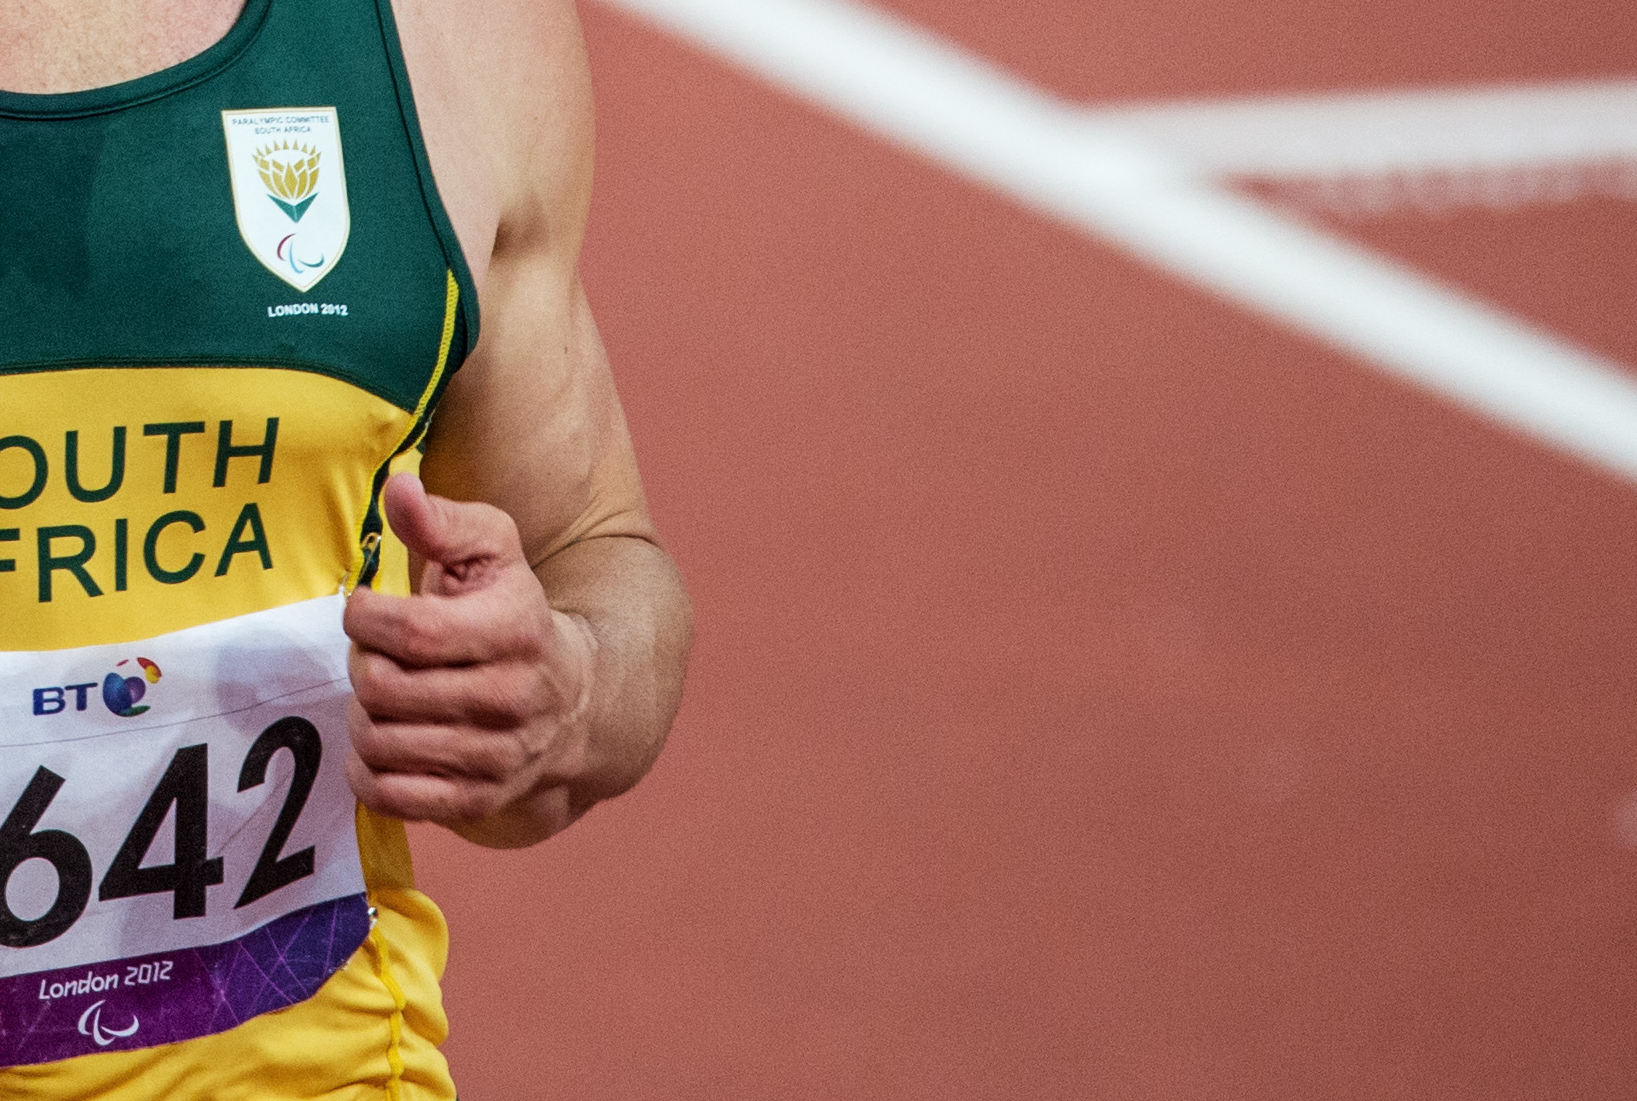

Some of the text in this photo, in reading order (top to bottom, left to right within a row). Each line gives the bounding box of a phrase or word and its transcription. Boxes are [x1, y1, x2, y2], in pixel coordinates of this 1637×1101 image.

[254, 125, 312, 135] SOUTH AFRICA
[267, 302, 349, 318] LONDON 2012
[32, 682, 98, 716] BT
[39, 960, 174, 1000] London 2012
